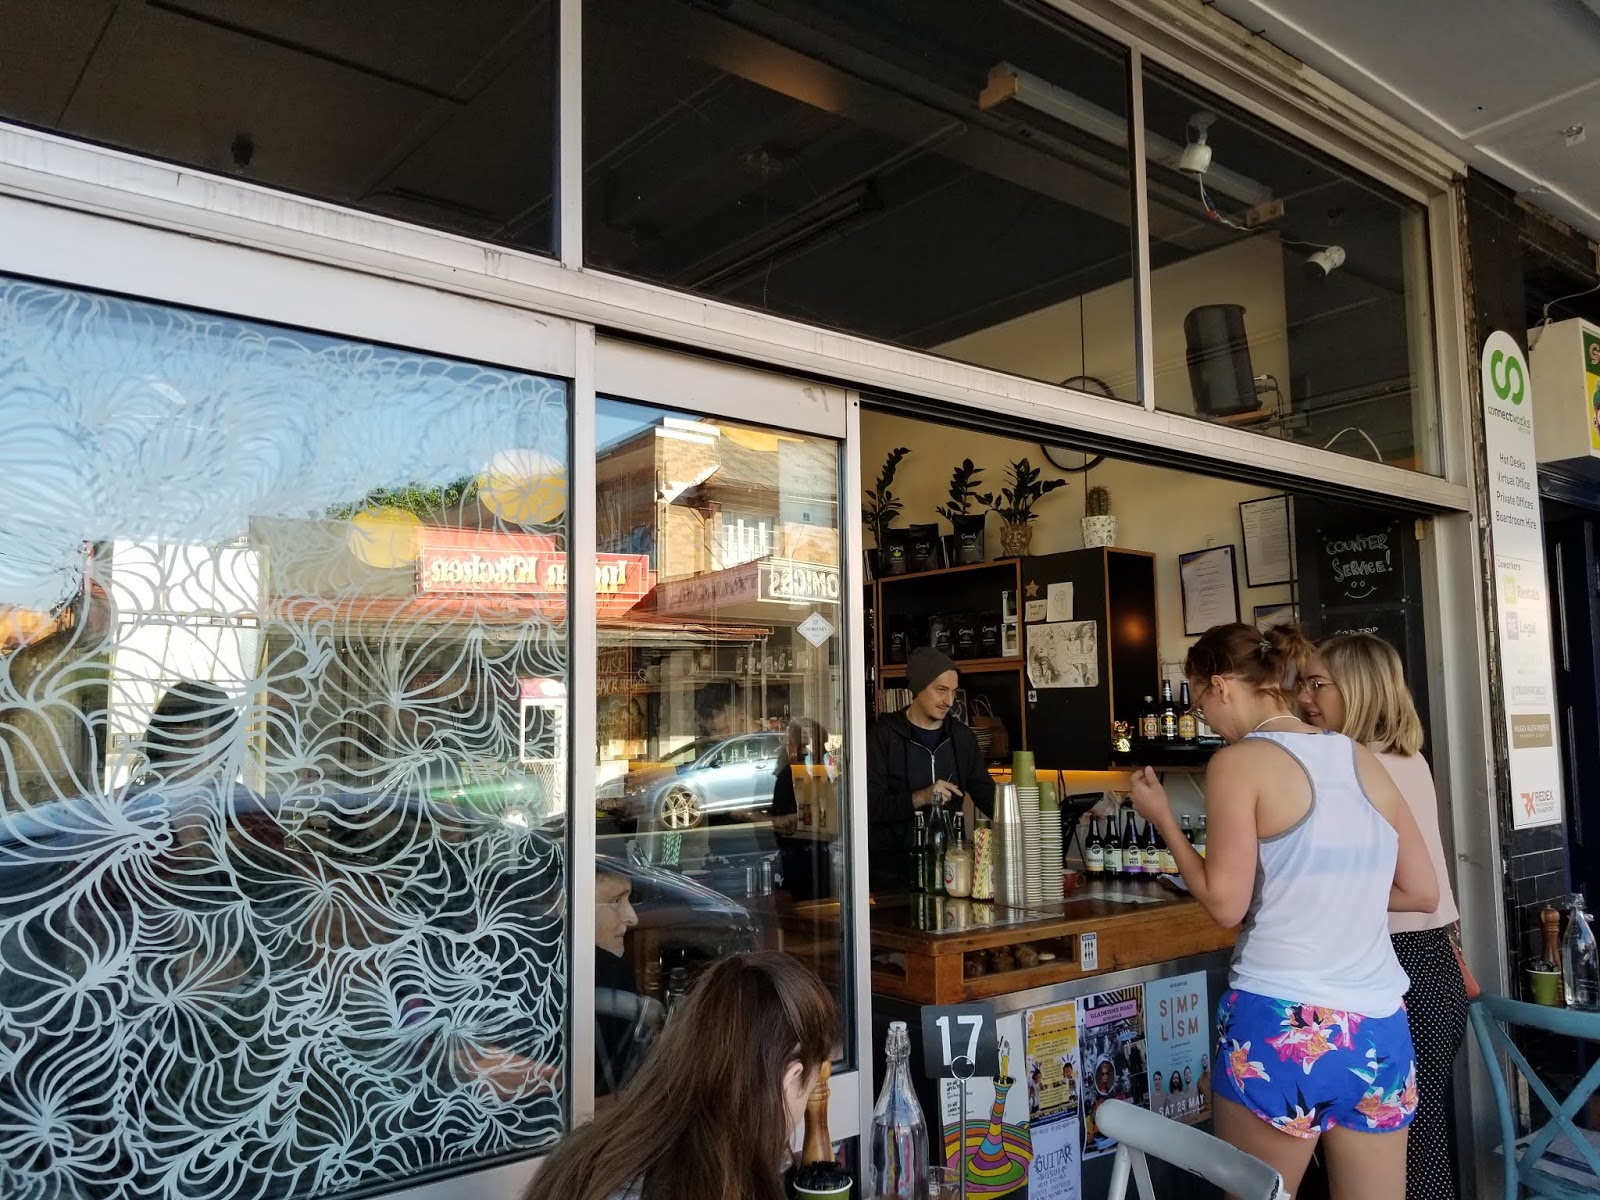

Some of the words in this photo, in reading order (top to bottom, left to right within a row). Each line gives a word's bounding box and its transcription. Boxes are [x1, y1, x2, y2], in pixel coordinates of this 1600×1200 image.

[1487, 405, 1531, 429] connectworks
[1499, 452, 1509, 466] Hot
[1510, 456, 1526, 470] Desks
[1497, 470, 1515, 487] Virtual
[1515, 476, 1531, 490] Office
[1496, 490, 1515, 506] Private
[1516, 496, 1534, 510] Offices
[1496, 510, 1525, 526] Boardroom
[1525, 517, 1537, 530] Hire
[1325, 534, 1389, 555] COUNTER
[1090, 1007, 1119, 1019] GLADSTONE
[1119, 1004, 1134, 1012] ROAD
[935, 1015, 984, 1066] 17
[1158, 1103, 1175, 1117] SAT
[1176, 1100, 1187, 1113] 25
[1188, 1093, 1206, 1109] MAY
[1034, 1144, 1073, 1173] GUITAR
